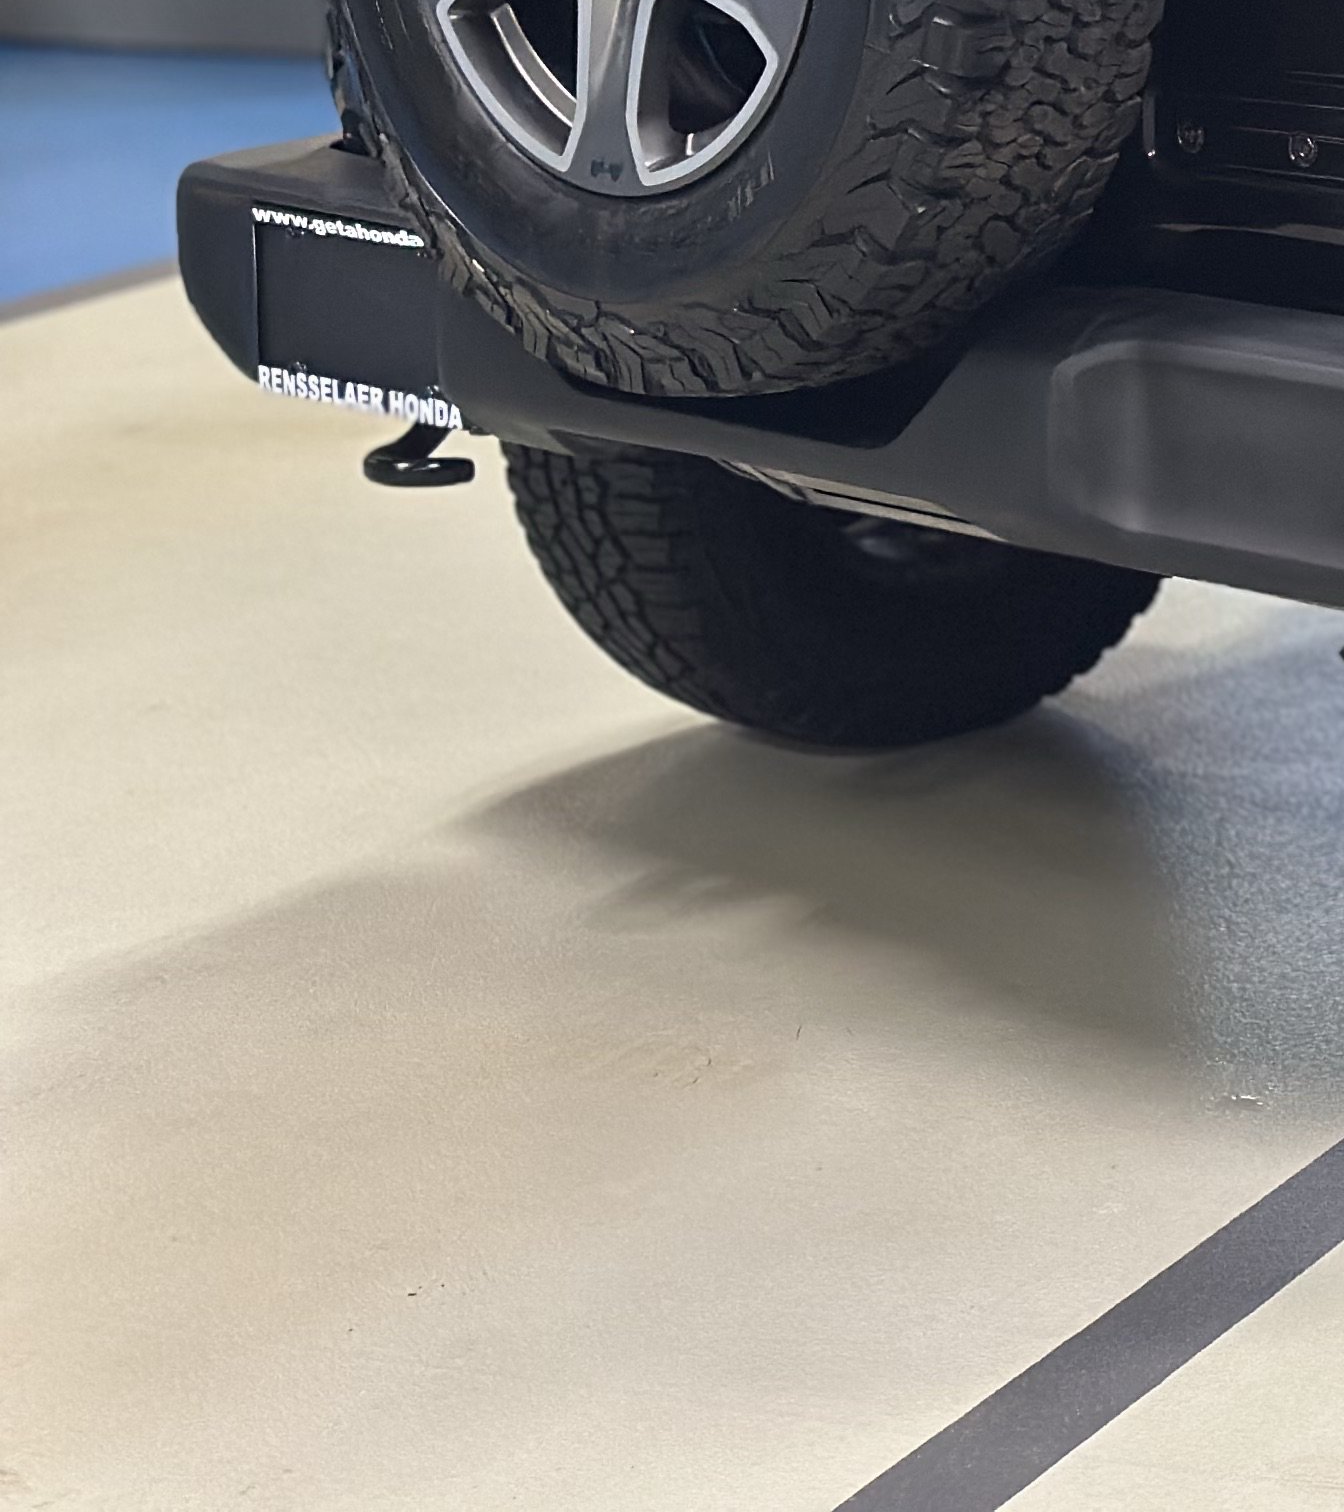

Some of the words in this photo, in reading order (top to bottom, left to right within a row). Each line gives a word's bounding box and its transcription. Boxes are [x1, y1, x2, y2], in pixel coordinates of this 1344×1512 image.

[252, 207, 425, 248] www.getahonda
[257, 364, 387, 415] RENSSELAER
[388, 390, 463, 430] HONDA
